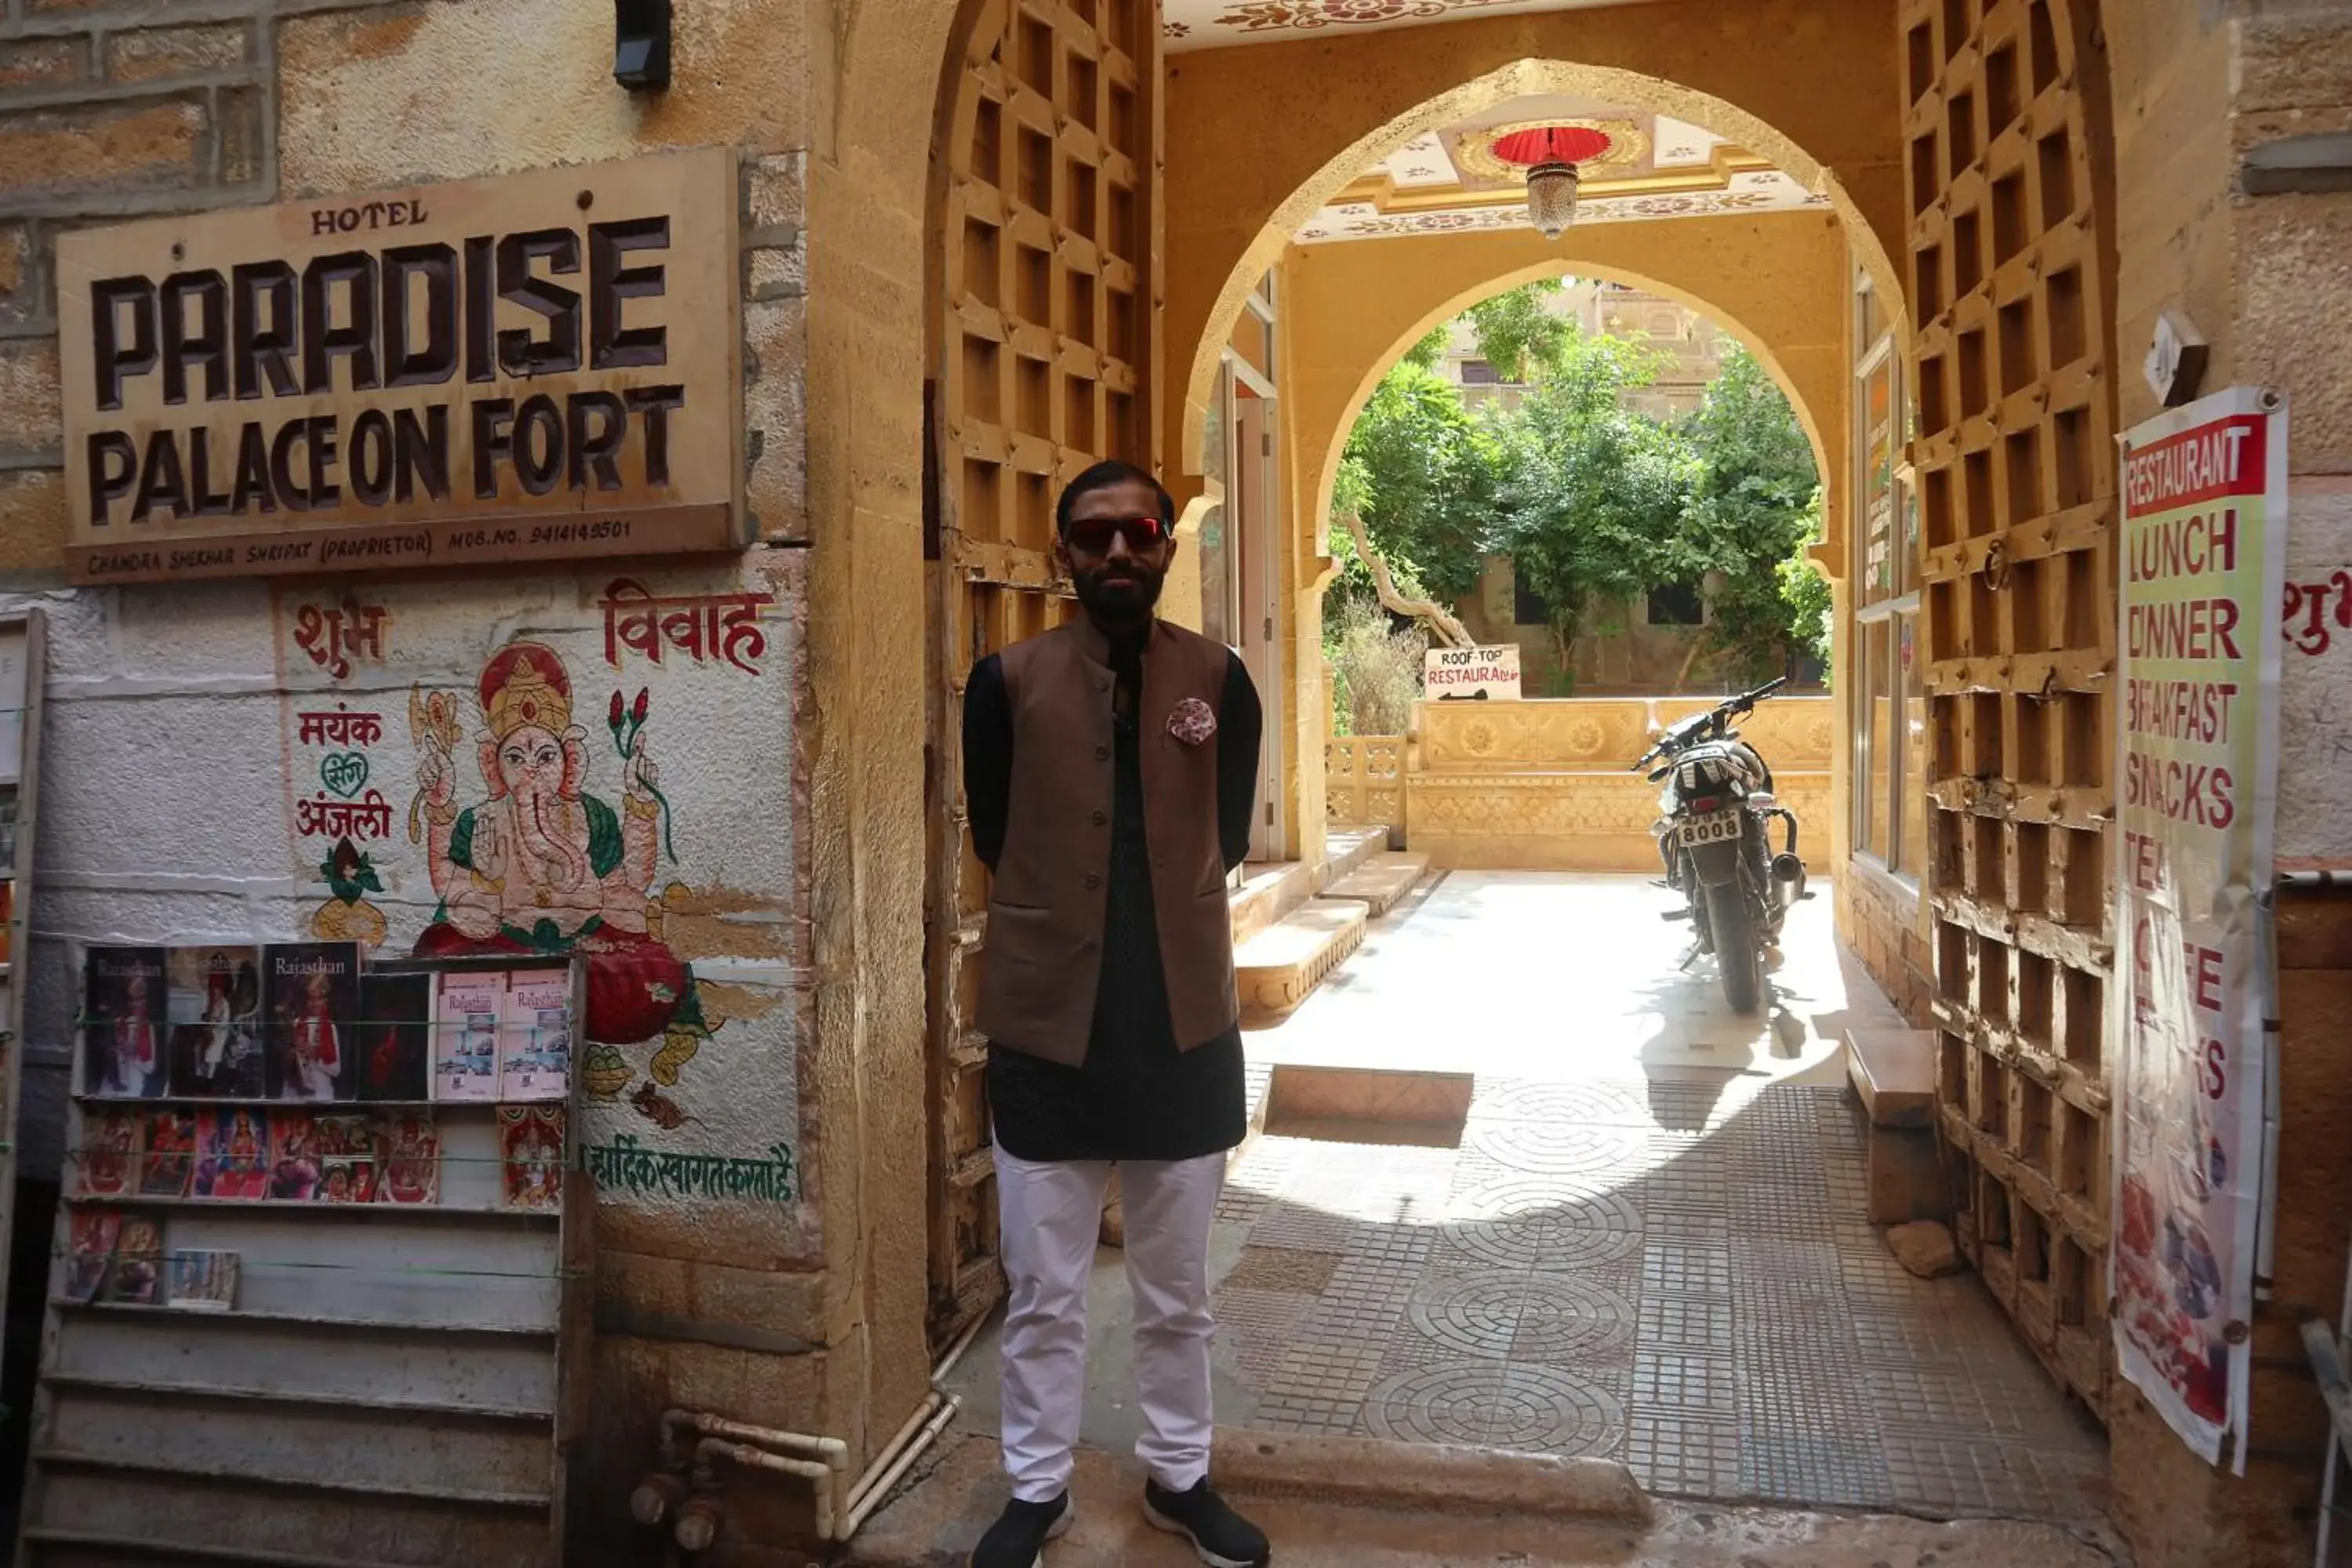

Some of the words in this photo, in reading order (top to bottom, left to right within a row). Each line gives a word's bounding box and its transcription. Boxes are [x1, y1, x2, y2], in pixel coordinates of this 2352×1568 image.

[311, 199, 429, 236] HOTEL
[90, 214, 670, 411] PARADISE
[473, 384, 684, 500] FORT
[2128, 426, 2251, 506] RESTAURANT
[168, 546, 235, 570] SHEKHAR
[319, 529, 433, 564] (PROPRIETOR)
[2129, 509, 2236, 582] LUNCH
[294, 594, 387, 680] शुभ
[597, 578, 775, 675] विवाह
[1442, 649, 1503, 666] ROOF-TOP
[297, 702, 382, 746] मयंक
[327, 758, 363, 788] संग
[296, 789, 394, 841] अंजली
[1683, 820, 1737, 843] 8008
[275, 956, 345, 978] Rajasthan
